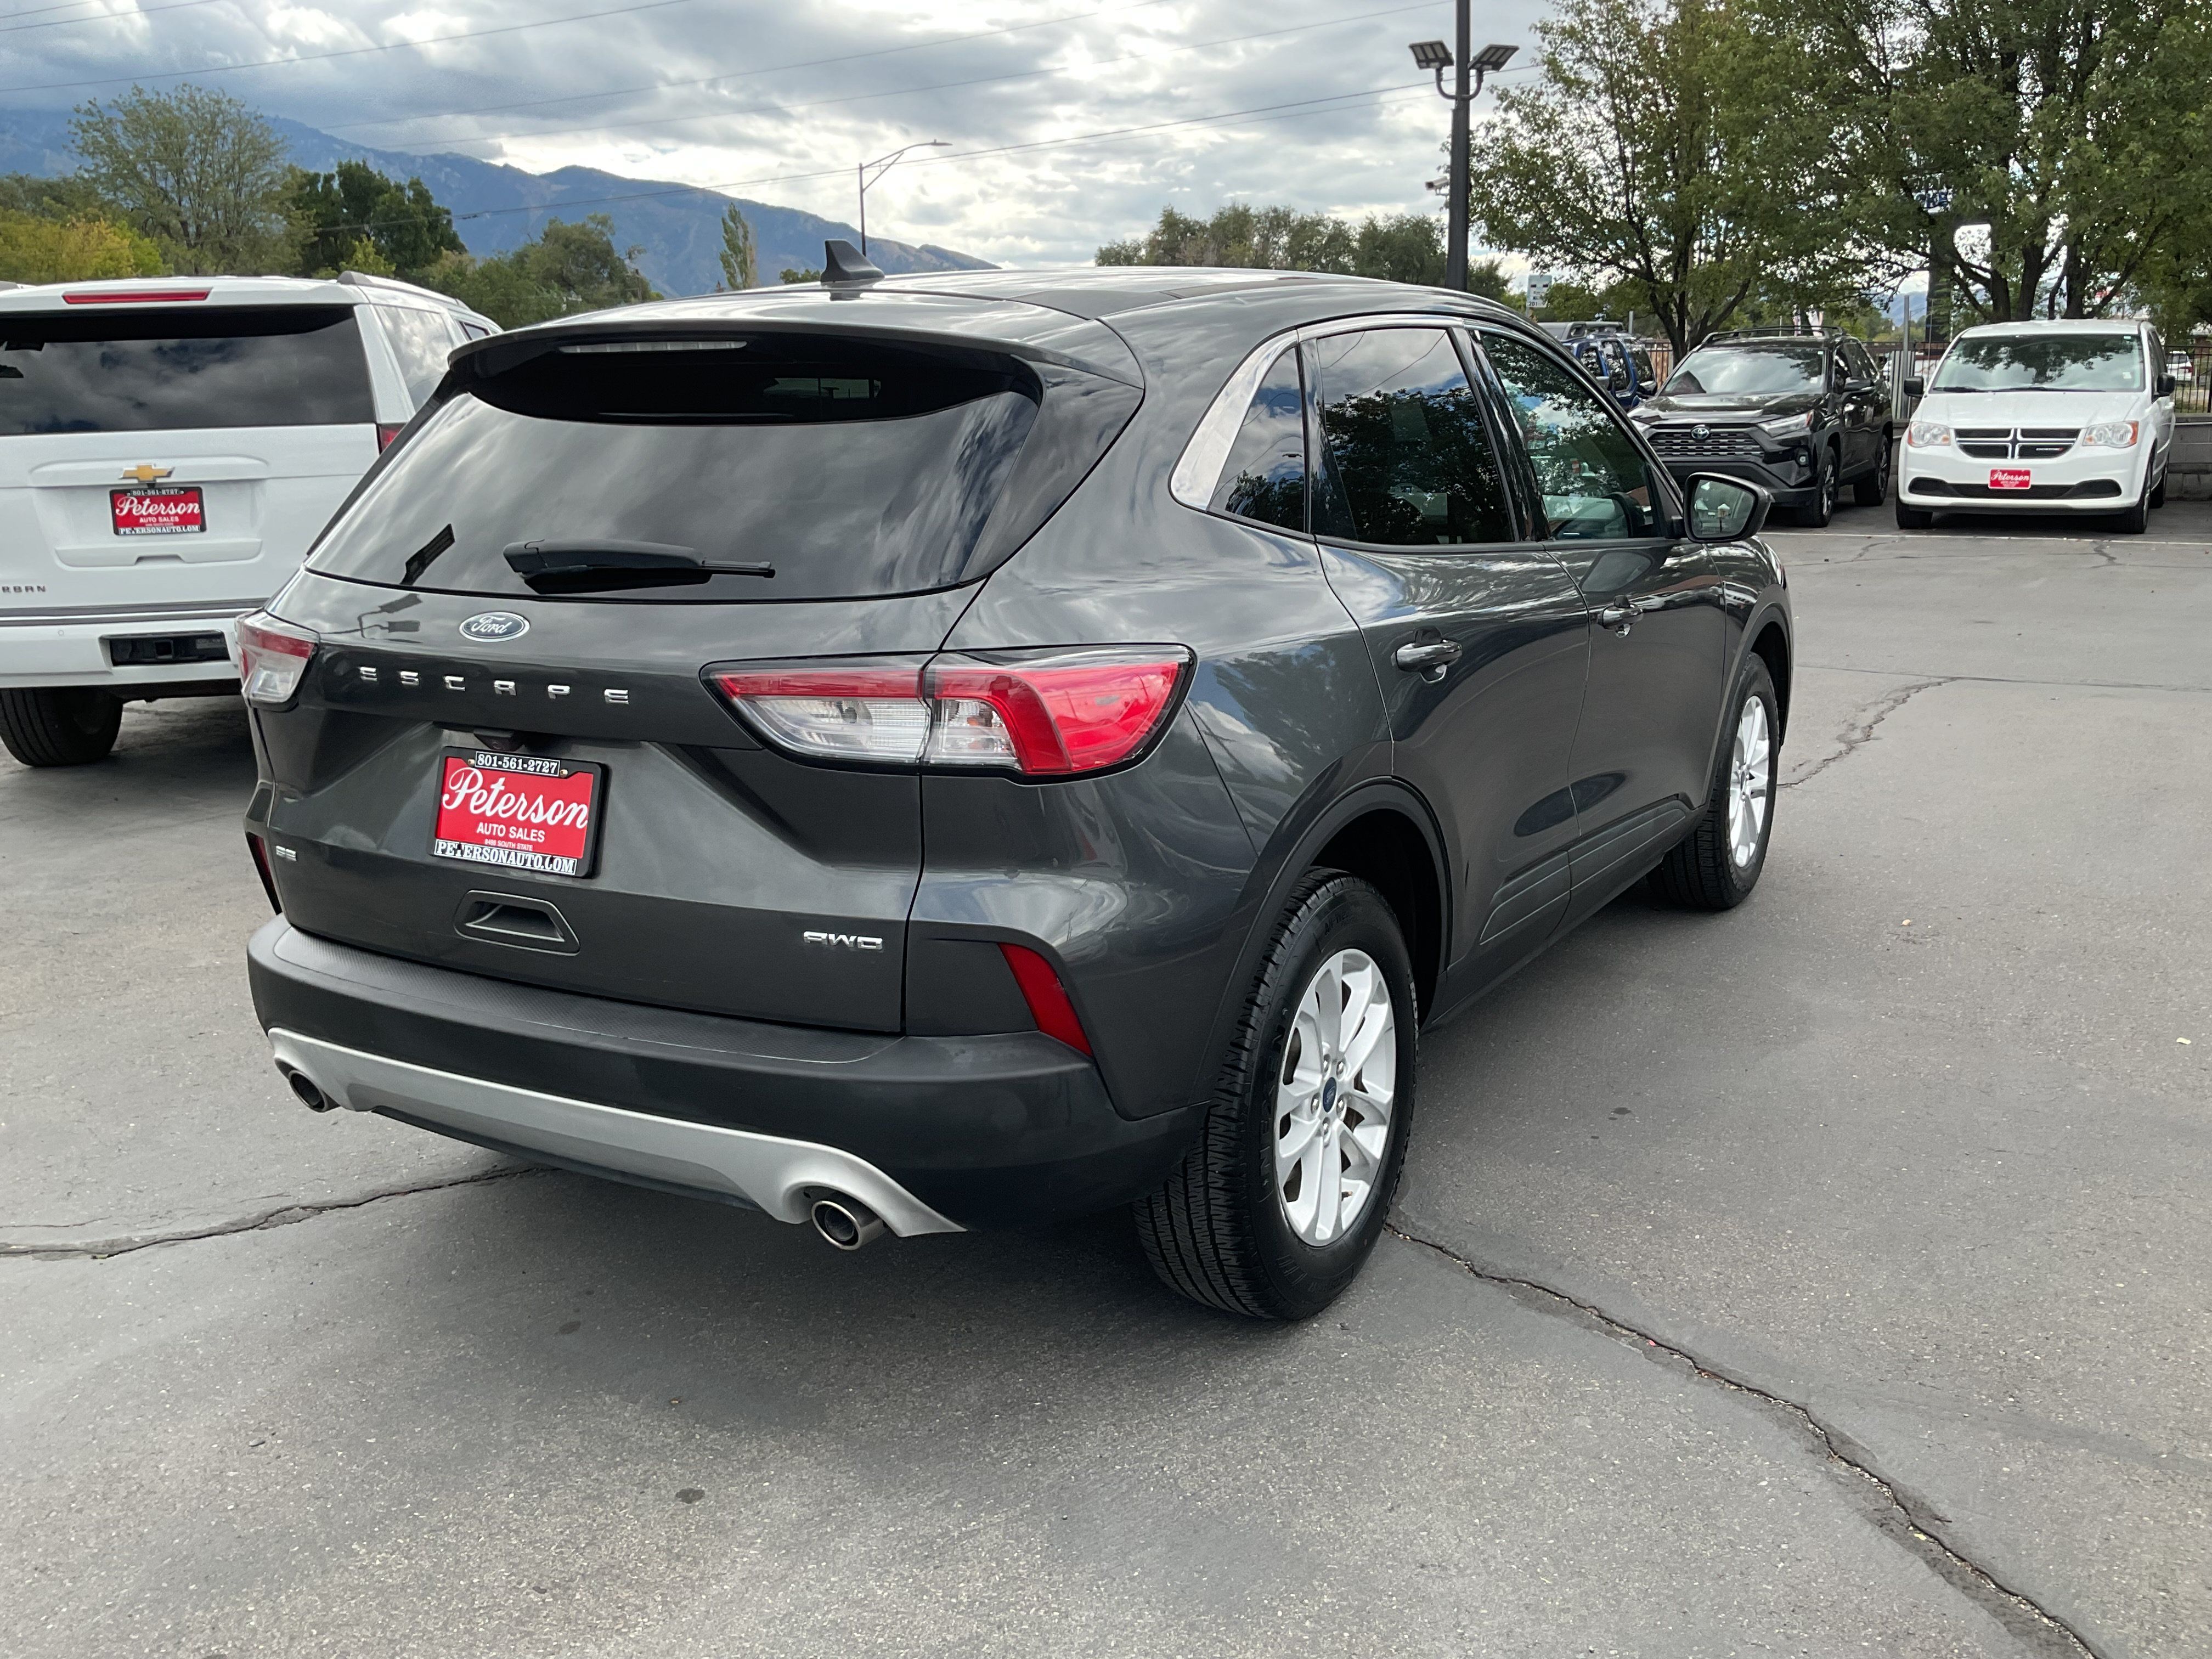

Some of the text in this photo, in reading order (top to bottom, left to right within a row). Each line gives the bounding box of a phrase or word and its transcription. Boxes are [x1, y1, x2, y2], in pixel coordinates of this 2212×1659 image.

[116, 496, 200, 516] Peterson
[471, 616, 512, 634] Ford
[359, 666, 629, 704] ESCAPE
[477, 753, 558, 774] 801-561-2727
[442, 767, 588, 829] Peterson
[476, 822, 546, 843] AUTO SALES
[497, 840, 516, 849] SOUTH
[516, 843, 534, 851] STATE
[803, 931, 883, 950] AWD
